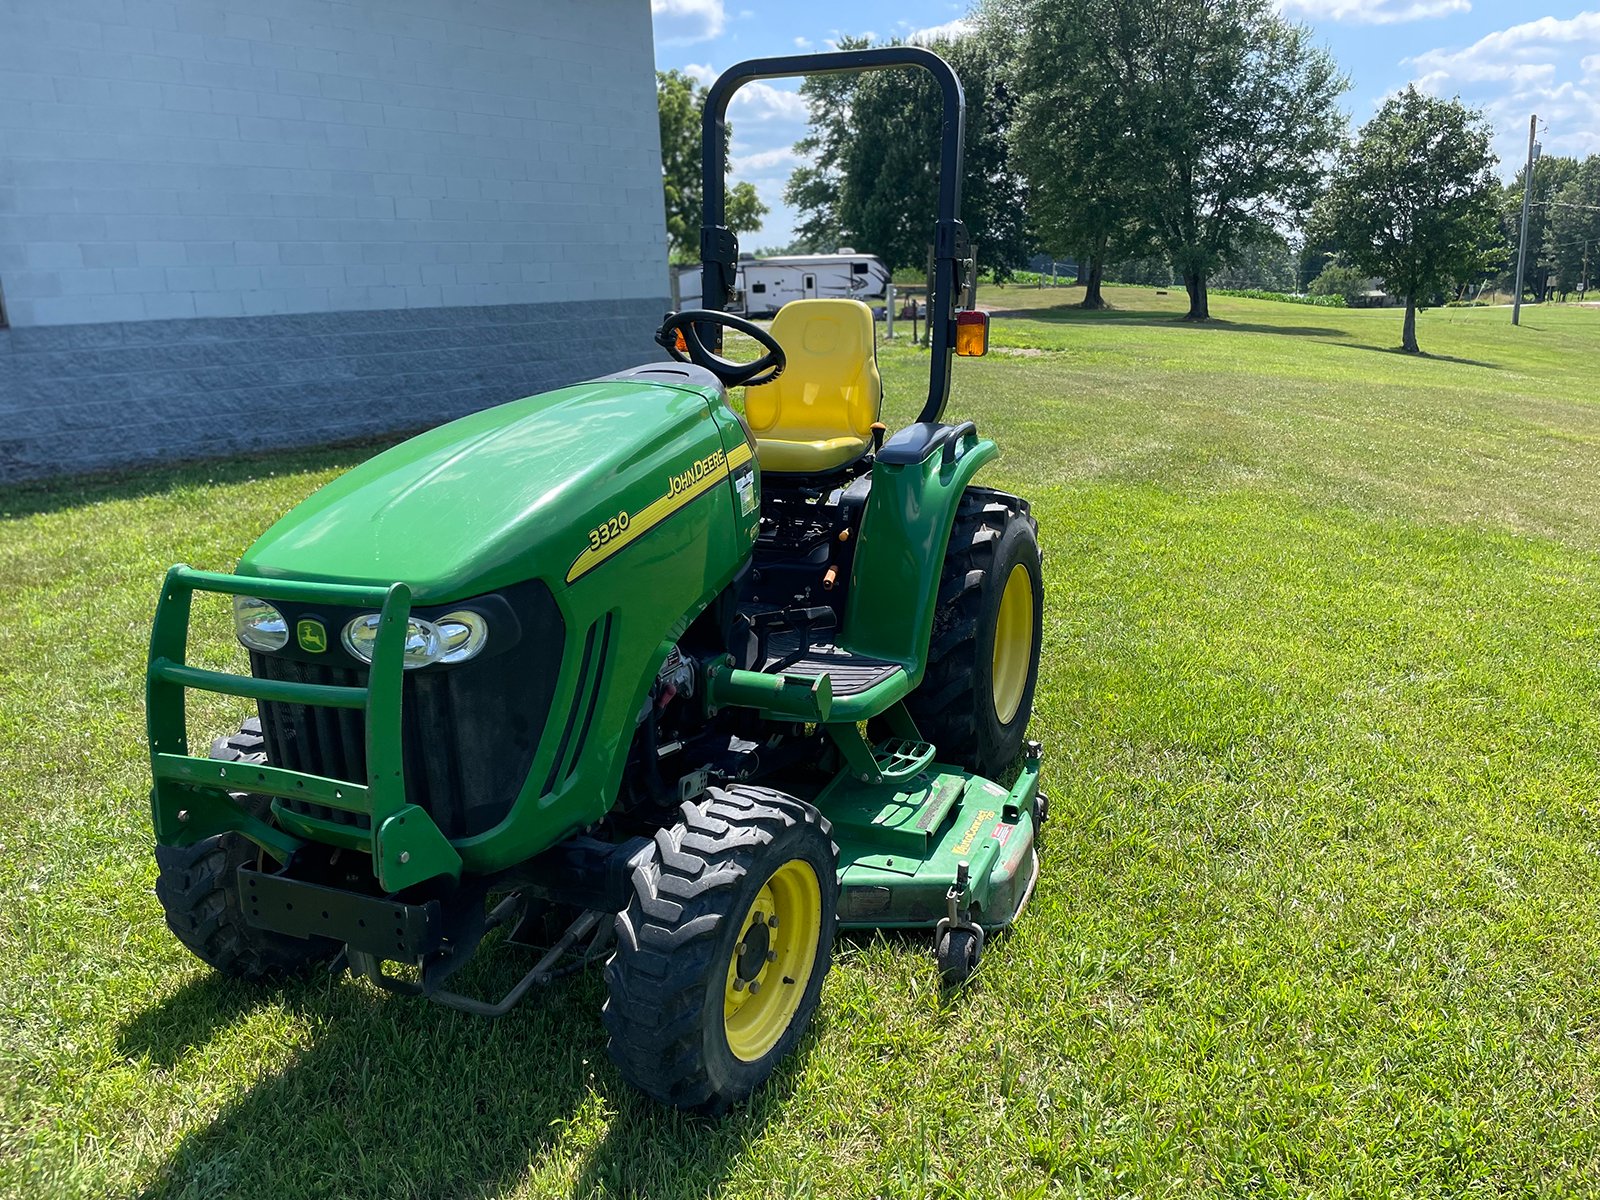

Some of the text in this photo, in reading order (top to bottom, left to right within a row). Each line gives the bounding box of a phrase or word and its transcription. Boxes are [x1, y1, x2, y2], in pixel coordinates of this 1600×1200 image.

[667, 448, 726, 499] JOHN DEERE
[588, 510, 630, 551] 3320
